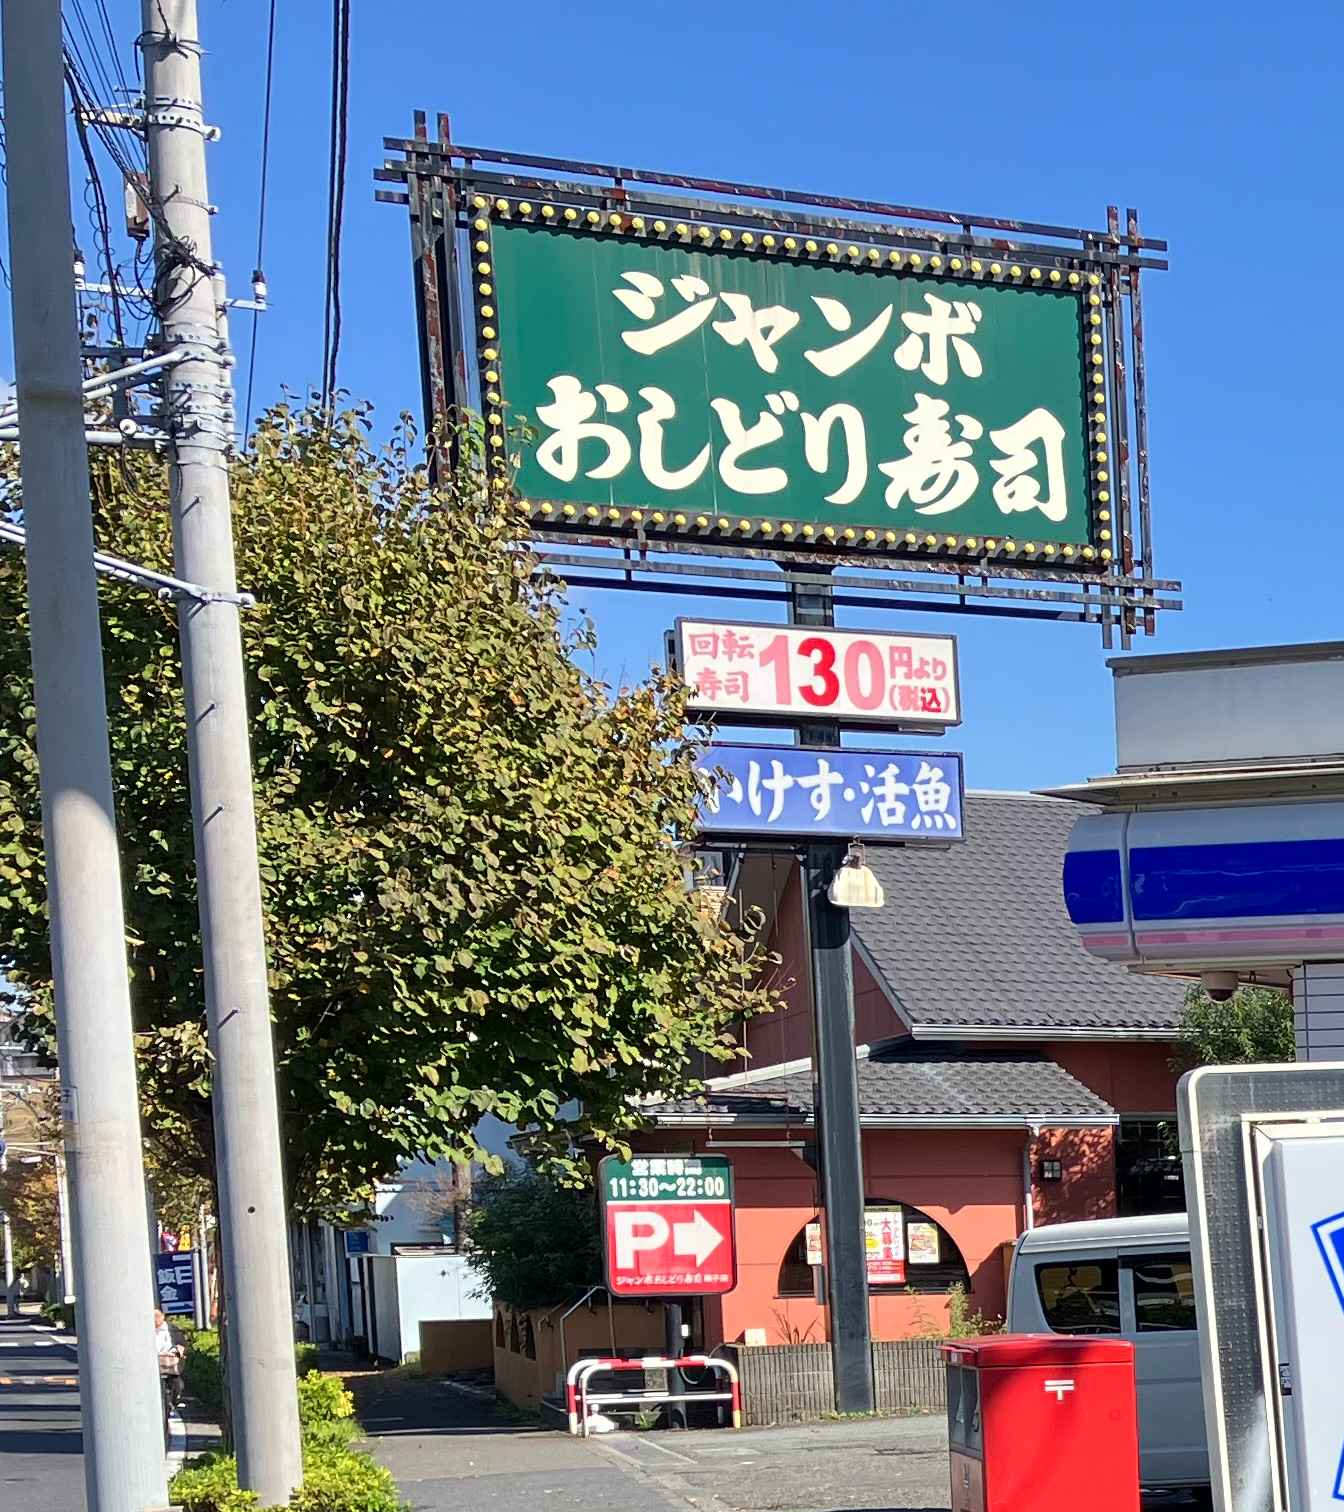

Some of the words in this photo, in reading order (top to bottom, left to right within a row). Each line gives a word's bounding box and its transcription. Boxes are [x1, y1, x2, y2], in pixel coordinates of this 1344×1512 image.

[611, 271, 983, 385] ジャンボ
[535, 374, 1068, 523] おしどり寿司
[689, 630, 755, 661] 回転
[758, 634, 886, 711] 130
[889, 646, 948, 682] 円より
[695, 667, 750, 702] 寿司
[613, 1211, 670, 1270] P
